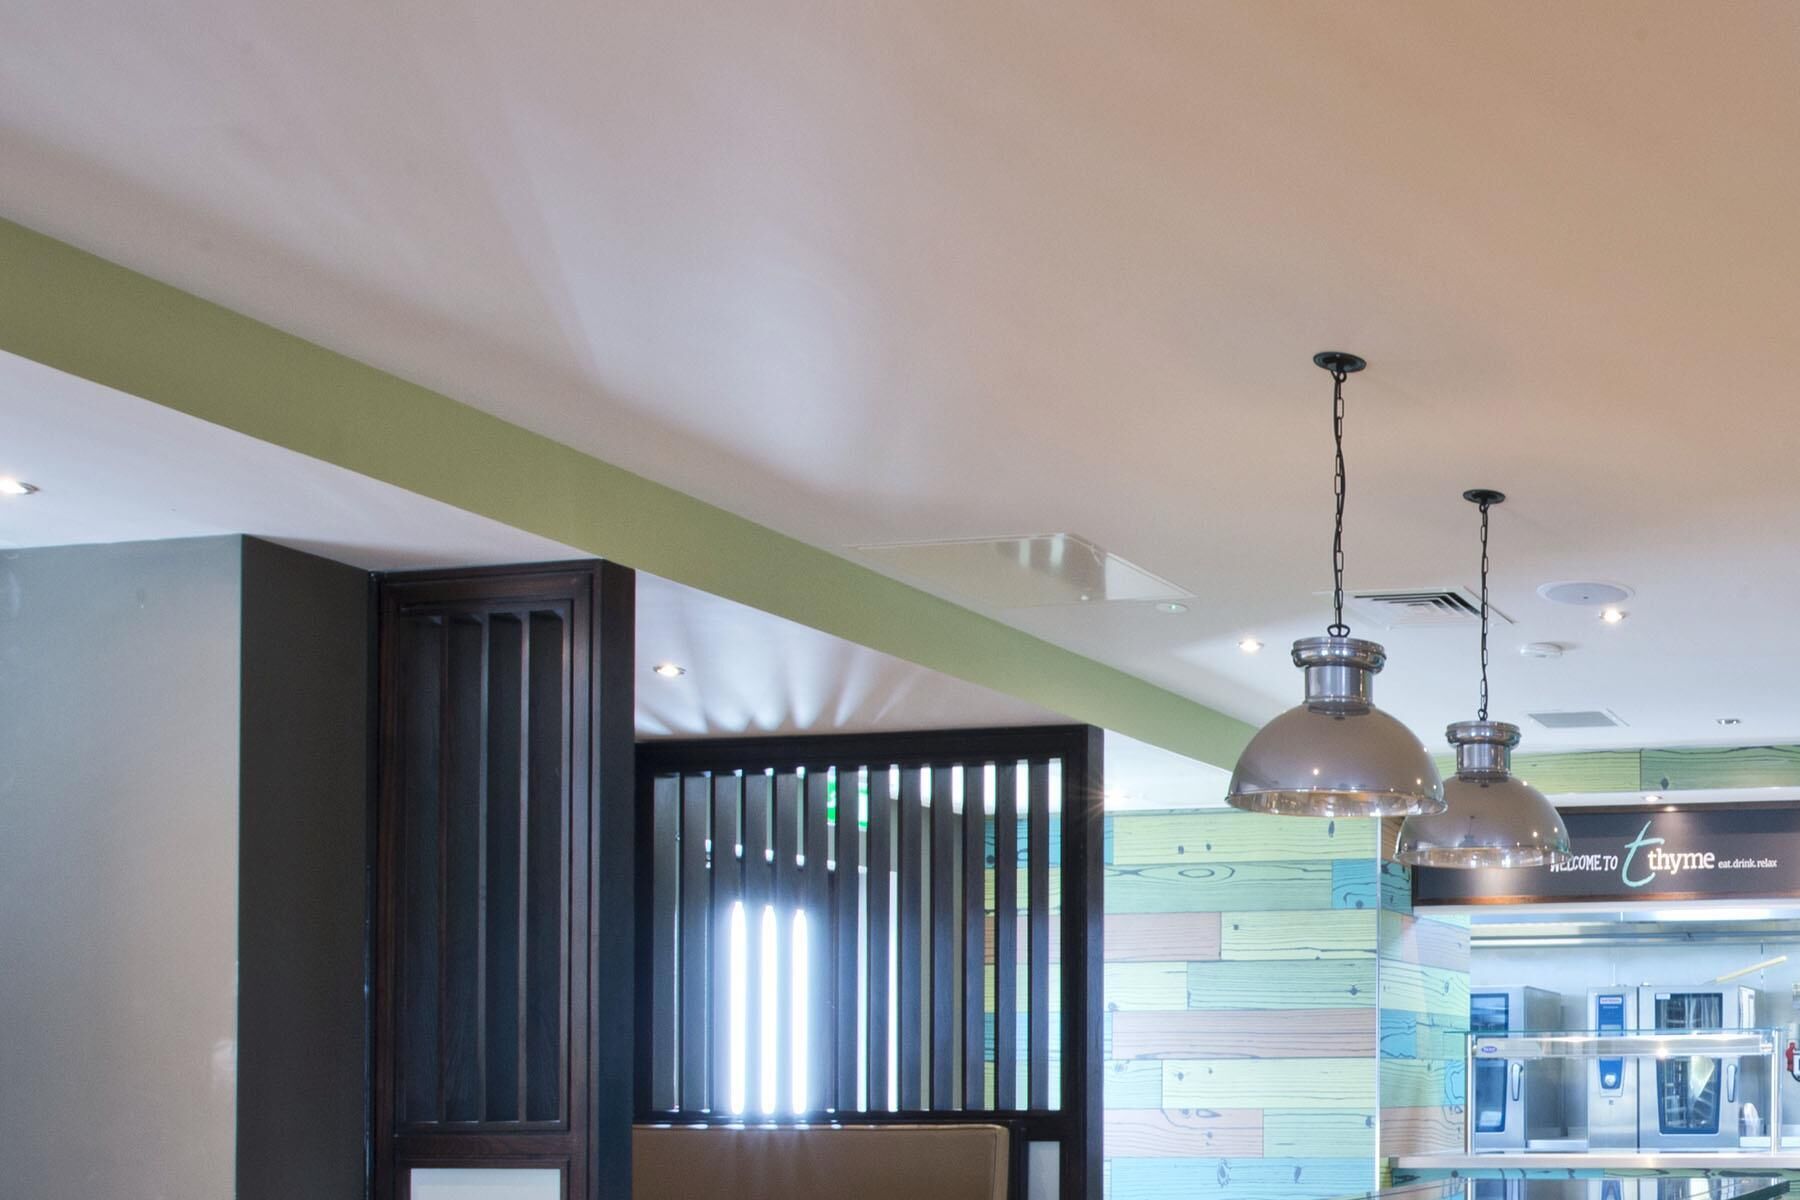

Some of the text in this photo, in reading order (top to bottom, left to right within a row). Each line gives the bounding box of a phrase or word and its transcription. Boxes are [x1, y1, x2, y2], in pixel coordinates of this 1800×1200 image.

[1550, 851, 1601, 872] WELCOME
[1604, 855, 1618, 870] TO
[1648, 848, 1715, 875] thyme
